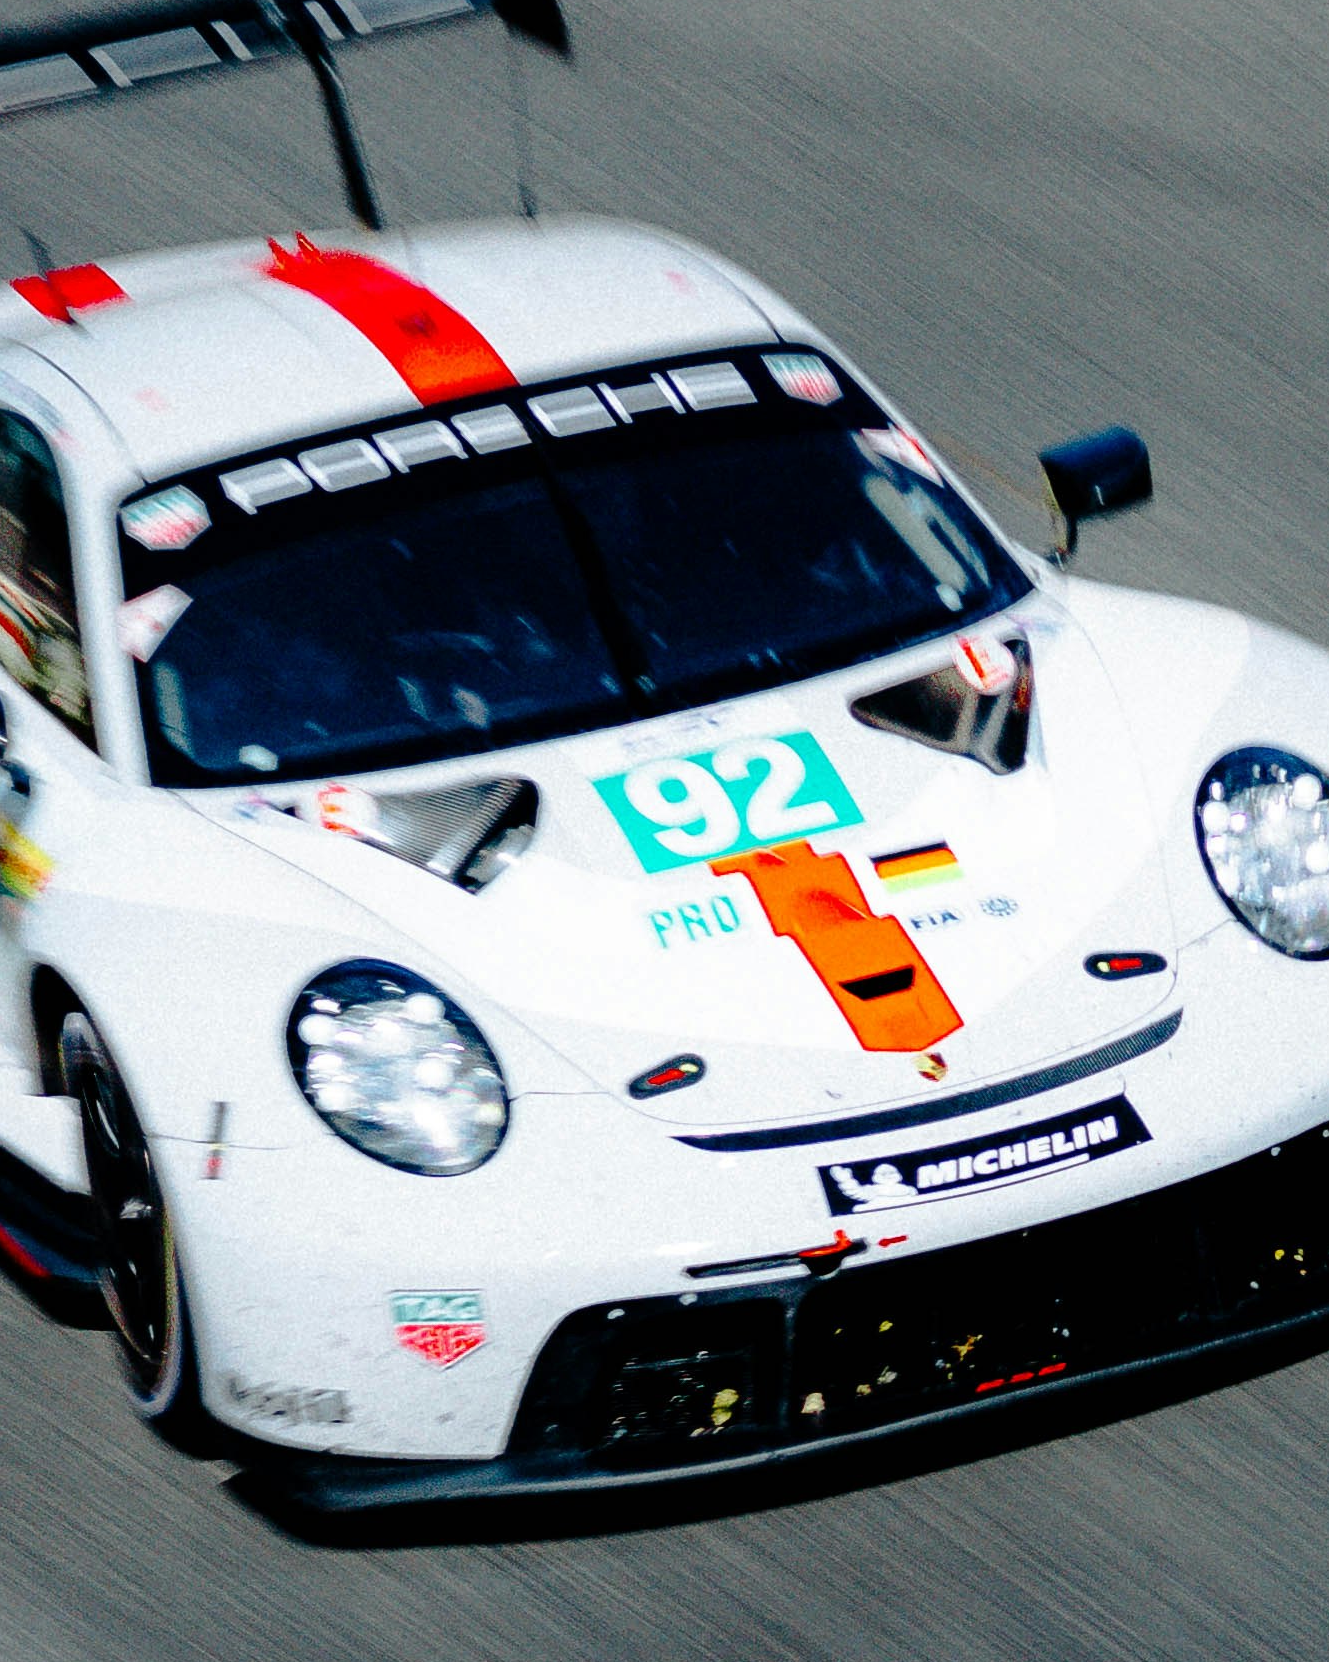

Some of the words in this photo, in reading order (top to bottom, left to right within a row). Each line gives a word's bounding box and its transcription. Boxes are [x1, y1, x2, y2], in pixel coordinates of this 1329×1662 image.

[622, 737, 841, 858] 92
[649, 895, 740, 949] PRO
[916, 1115, 1119, 1190] MICHELIN
